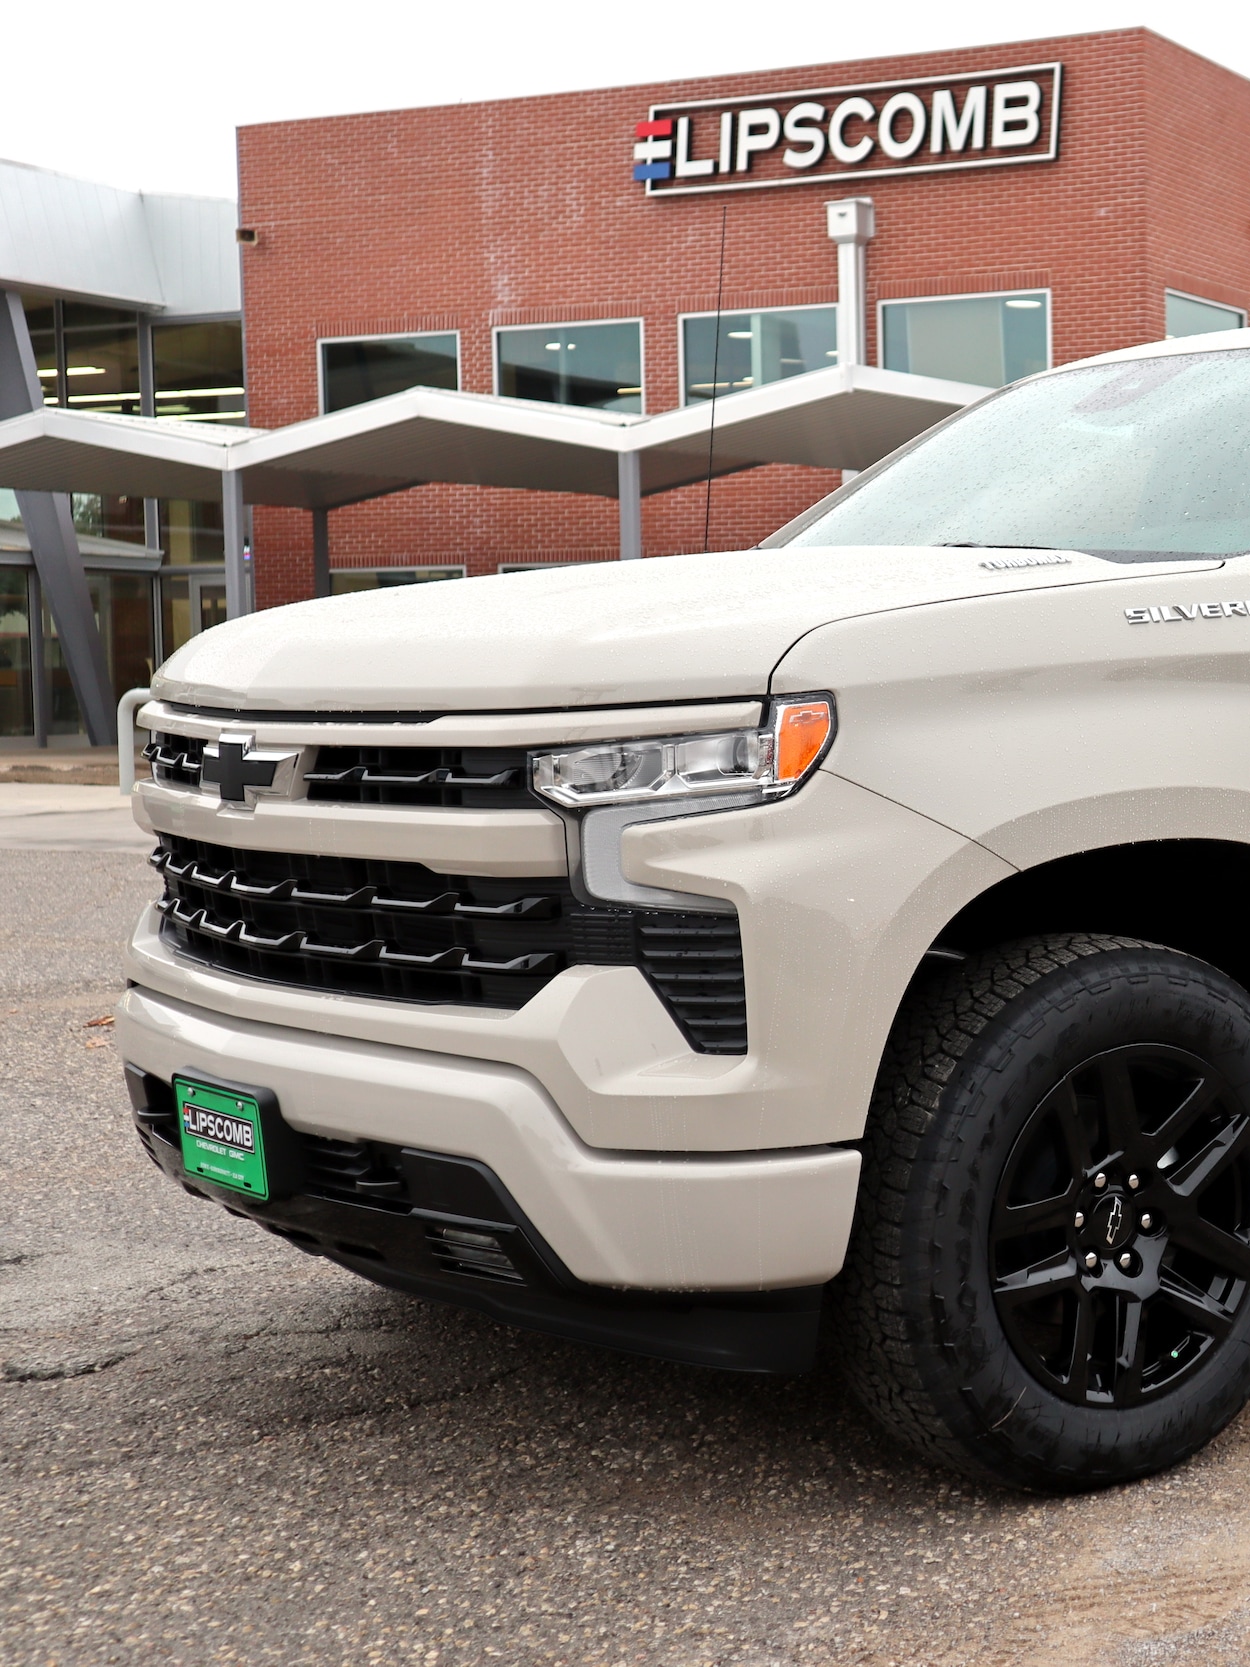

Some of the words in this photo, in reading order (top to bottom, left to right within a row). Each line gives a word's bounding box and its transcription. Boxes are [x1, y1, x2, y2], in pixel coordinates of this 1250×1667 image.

[675, 80, 1041, 177] LIPSCOMB
[978, 554, 1072, 571] TURBOMAX
[188, 1108, 253, 1148] LIPSCOMB
[196, 1140, 227, 1156] CHEVROLET
[228, 1149, 245, 1161] GMC
